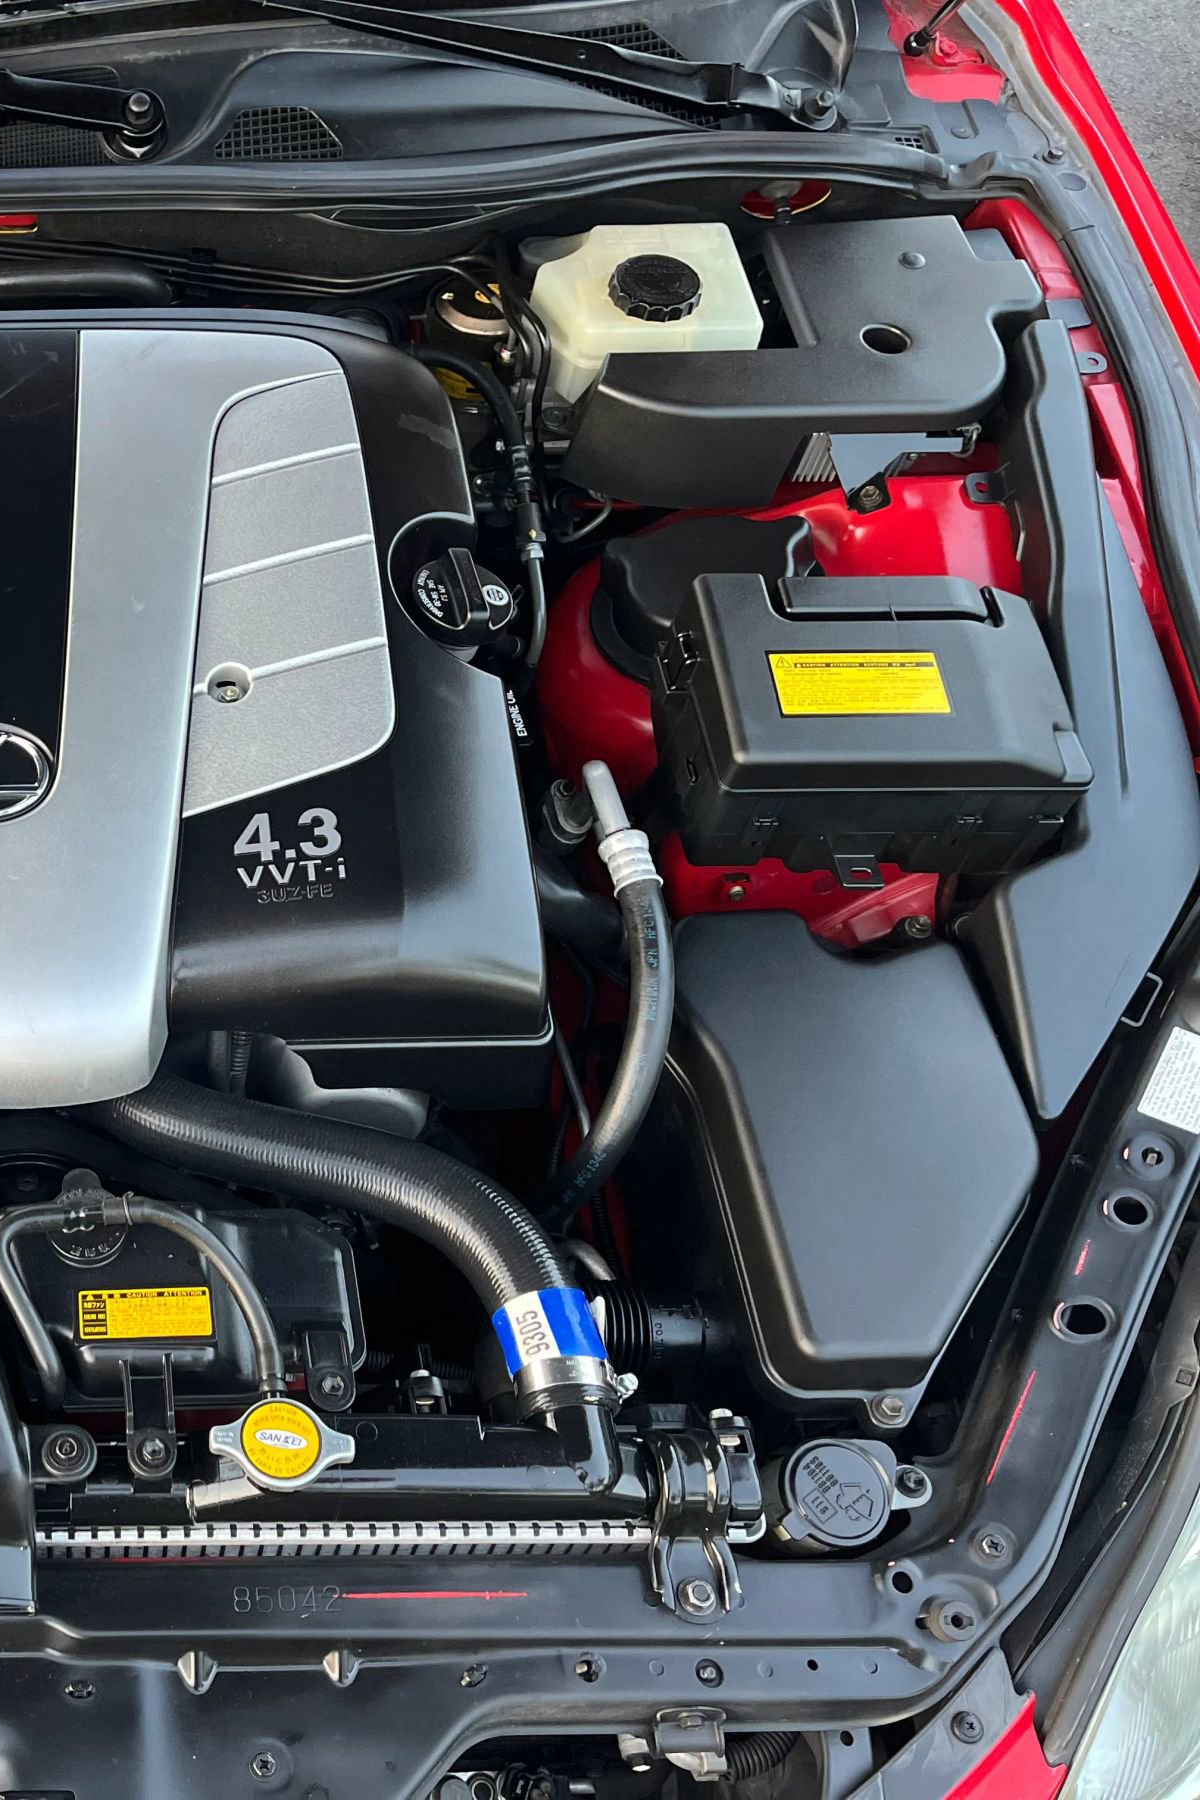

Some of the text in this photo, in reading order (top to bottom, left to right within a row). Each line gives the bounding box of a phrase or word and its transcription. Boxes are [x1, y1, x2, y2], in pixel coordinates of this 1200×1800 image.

[417, 589, 444, 618] CONSERVING
[508, 704, 528, 737] ENGINE
[234, 807, 342, 862] 4.3
[237, 857, 347, 889] VVT-i
[257, 883, 334, 904] 3UZ-FE
[126, 1291, 158, 1299] CAUTION
[515, 1309, 551, 1357] 9305
[269, 1405, 298, 1417] CAUTION
[258, 1431, 303, 1447] SANKEI
[233, 1585, 341, 1613] 85042
